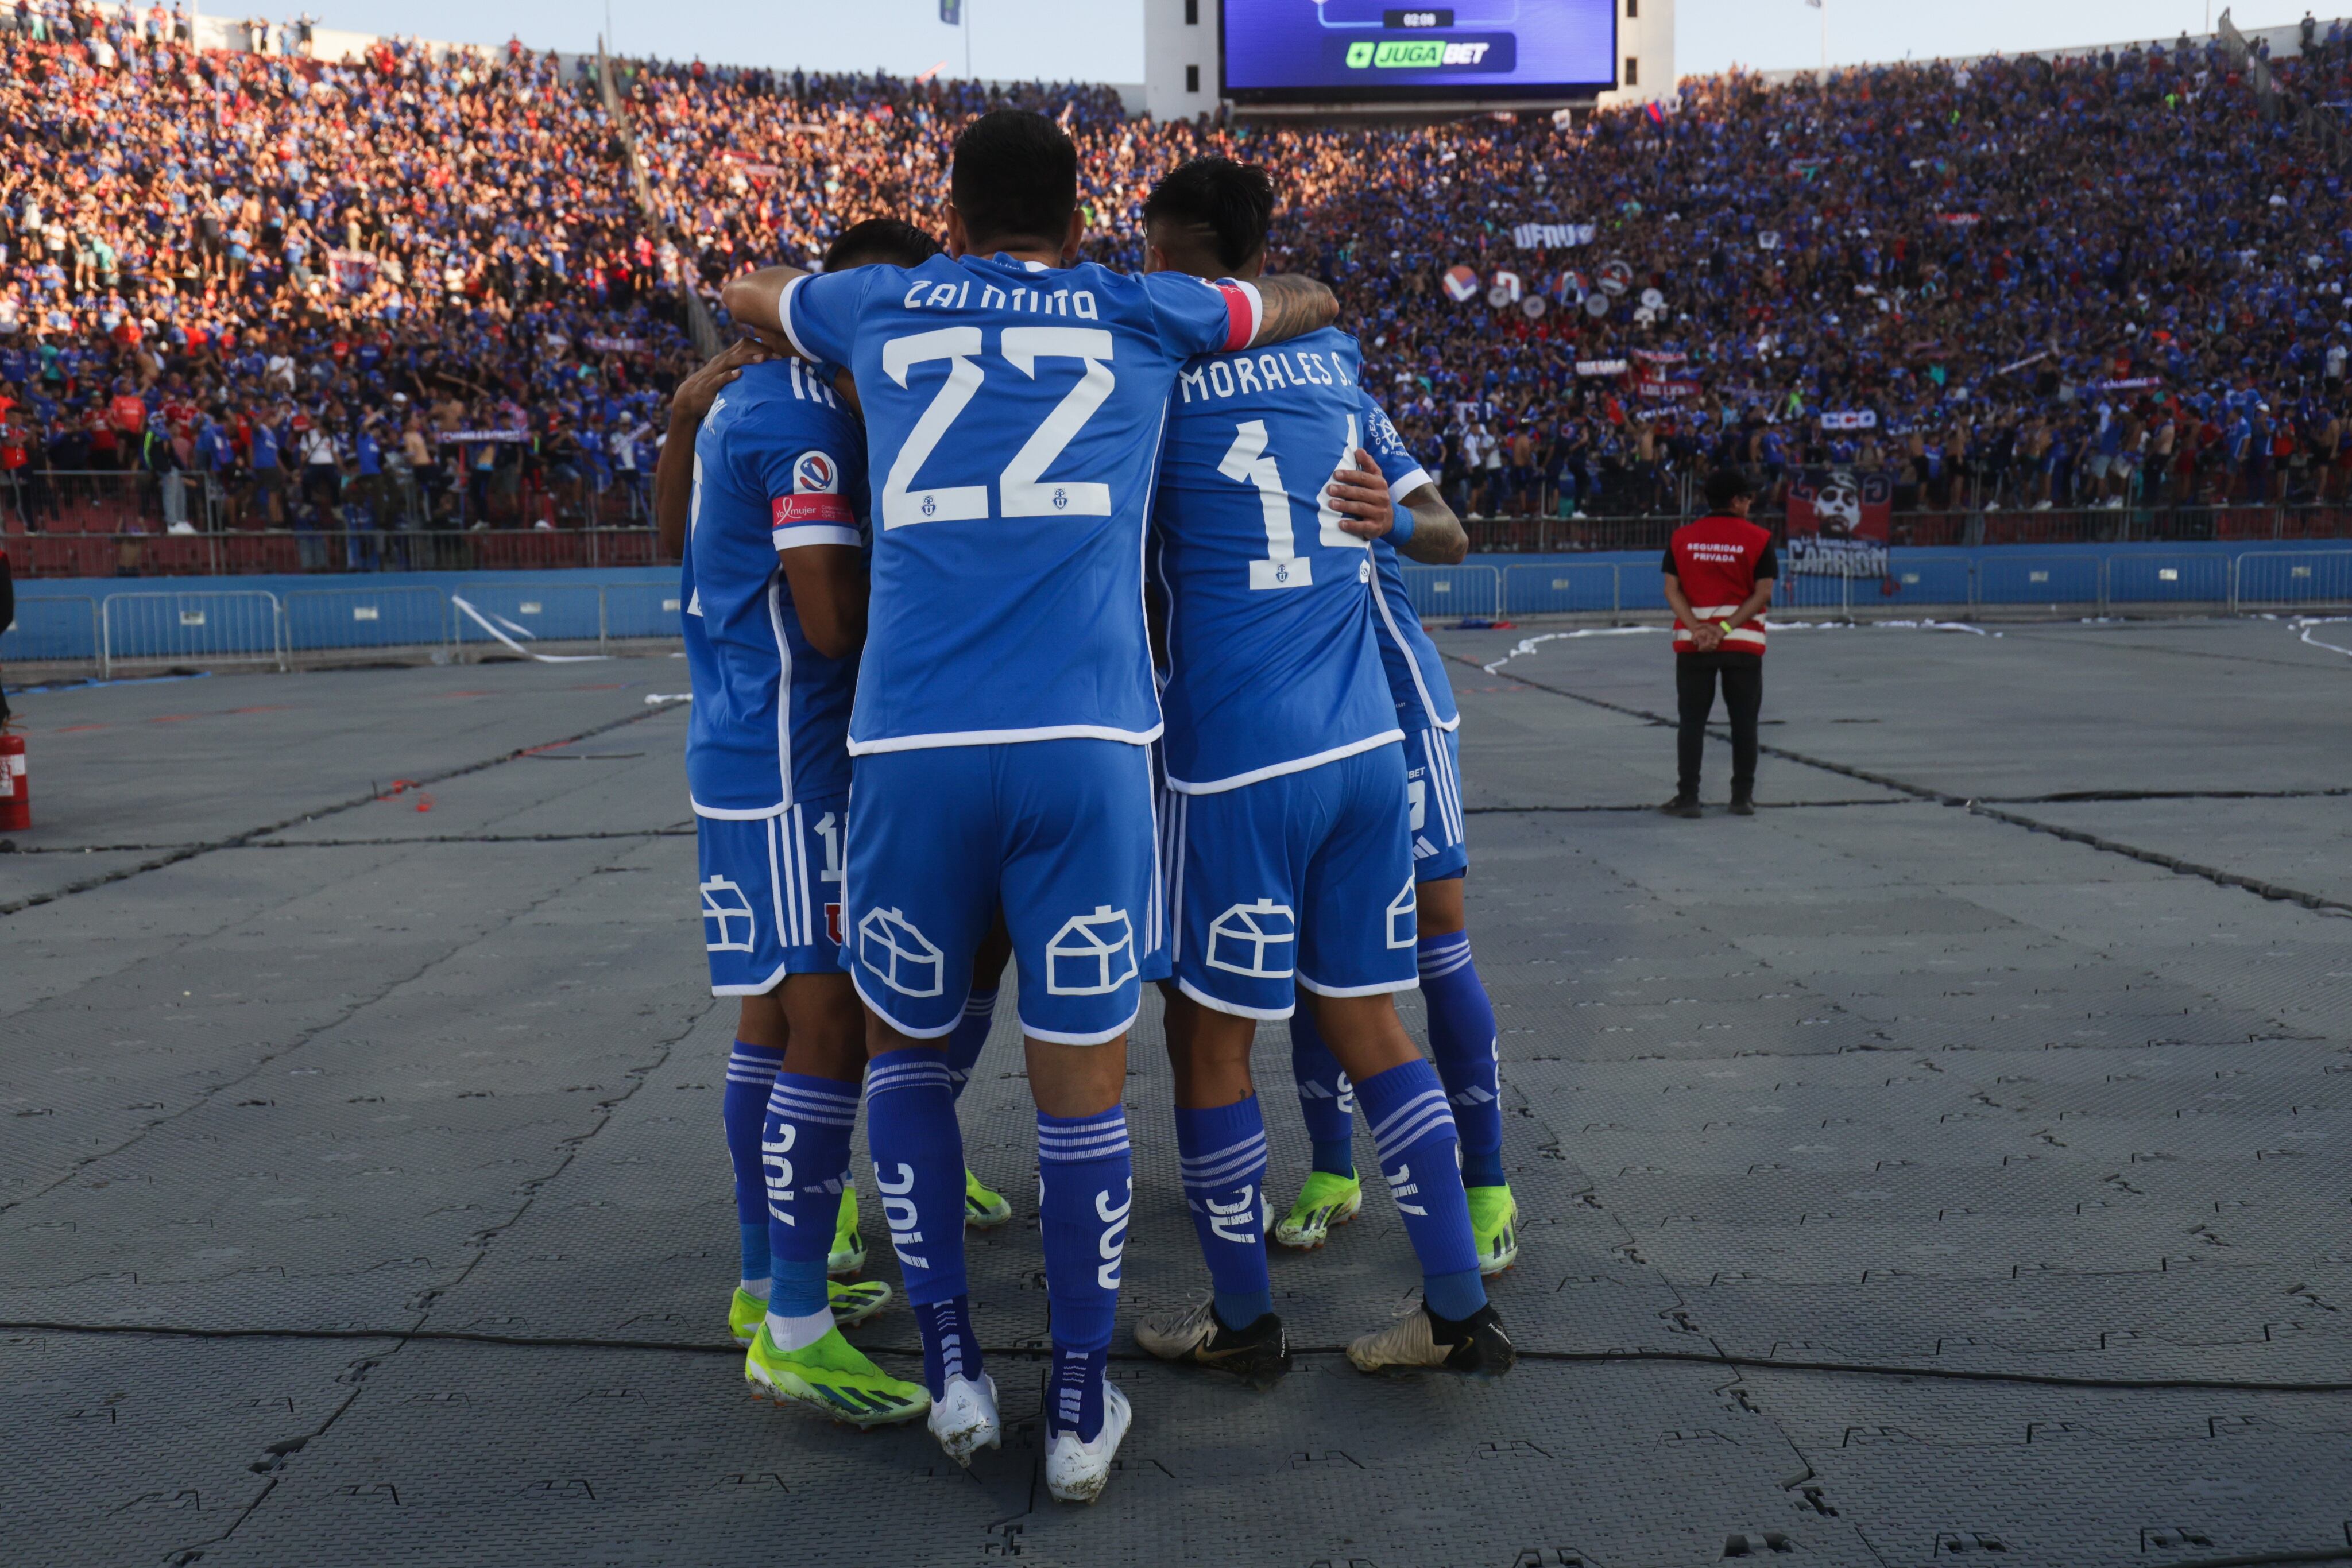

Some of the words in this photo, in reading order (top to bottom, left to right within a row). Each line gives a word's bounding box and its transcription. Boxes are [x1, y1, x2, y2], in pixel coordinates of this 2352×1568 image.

[1179, 353, 1333, 403] MORALES
[883, 326, 1115, 531] 22
[791, 506, 816, 516] mujer
[1687, 543, 1744, 553] SEGURIDAD
[1693, 552, 1735, 562] PRIVADA
